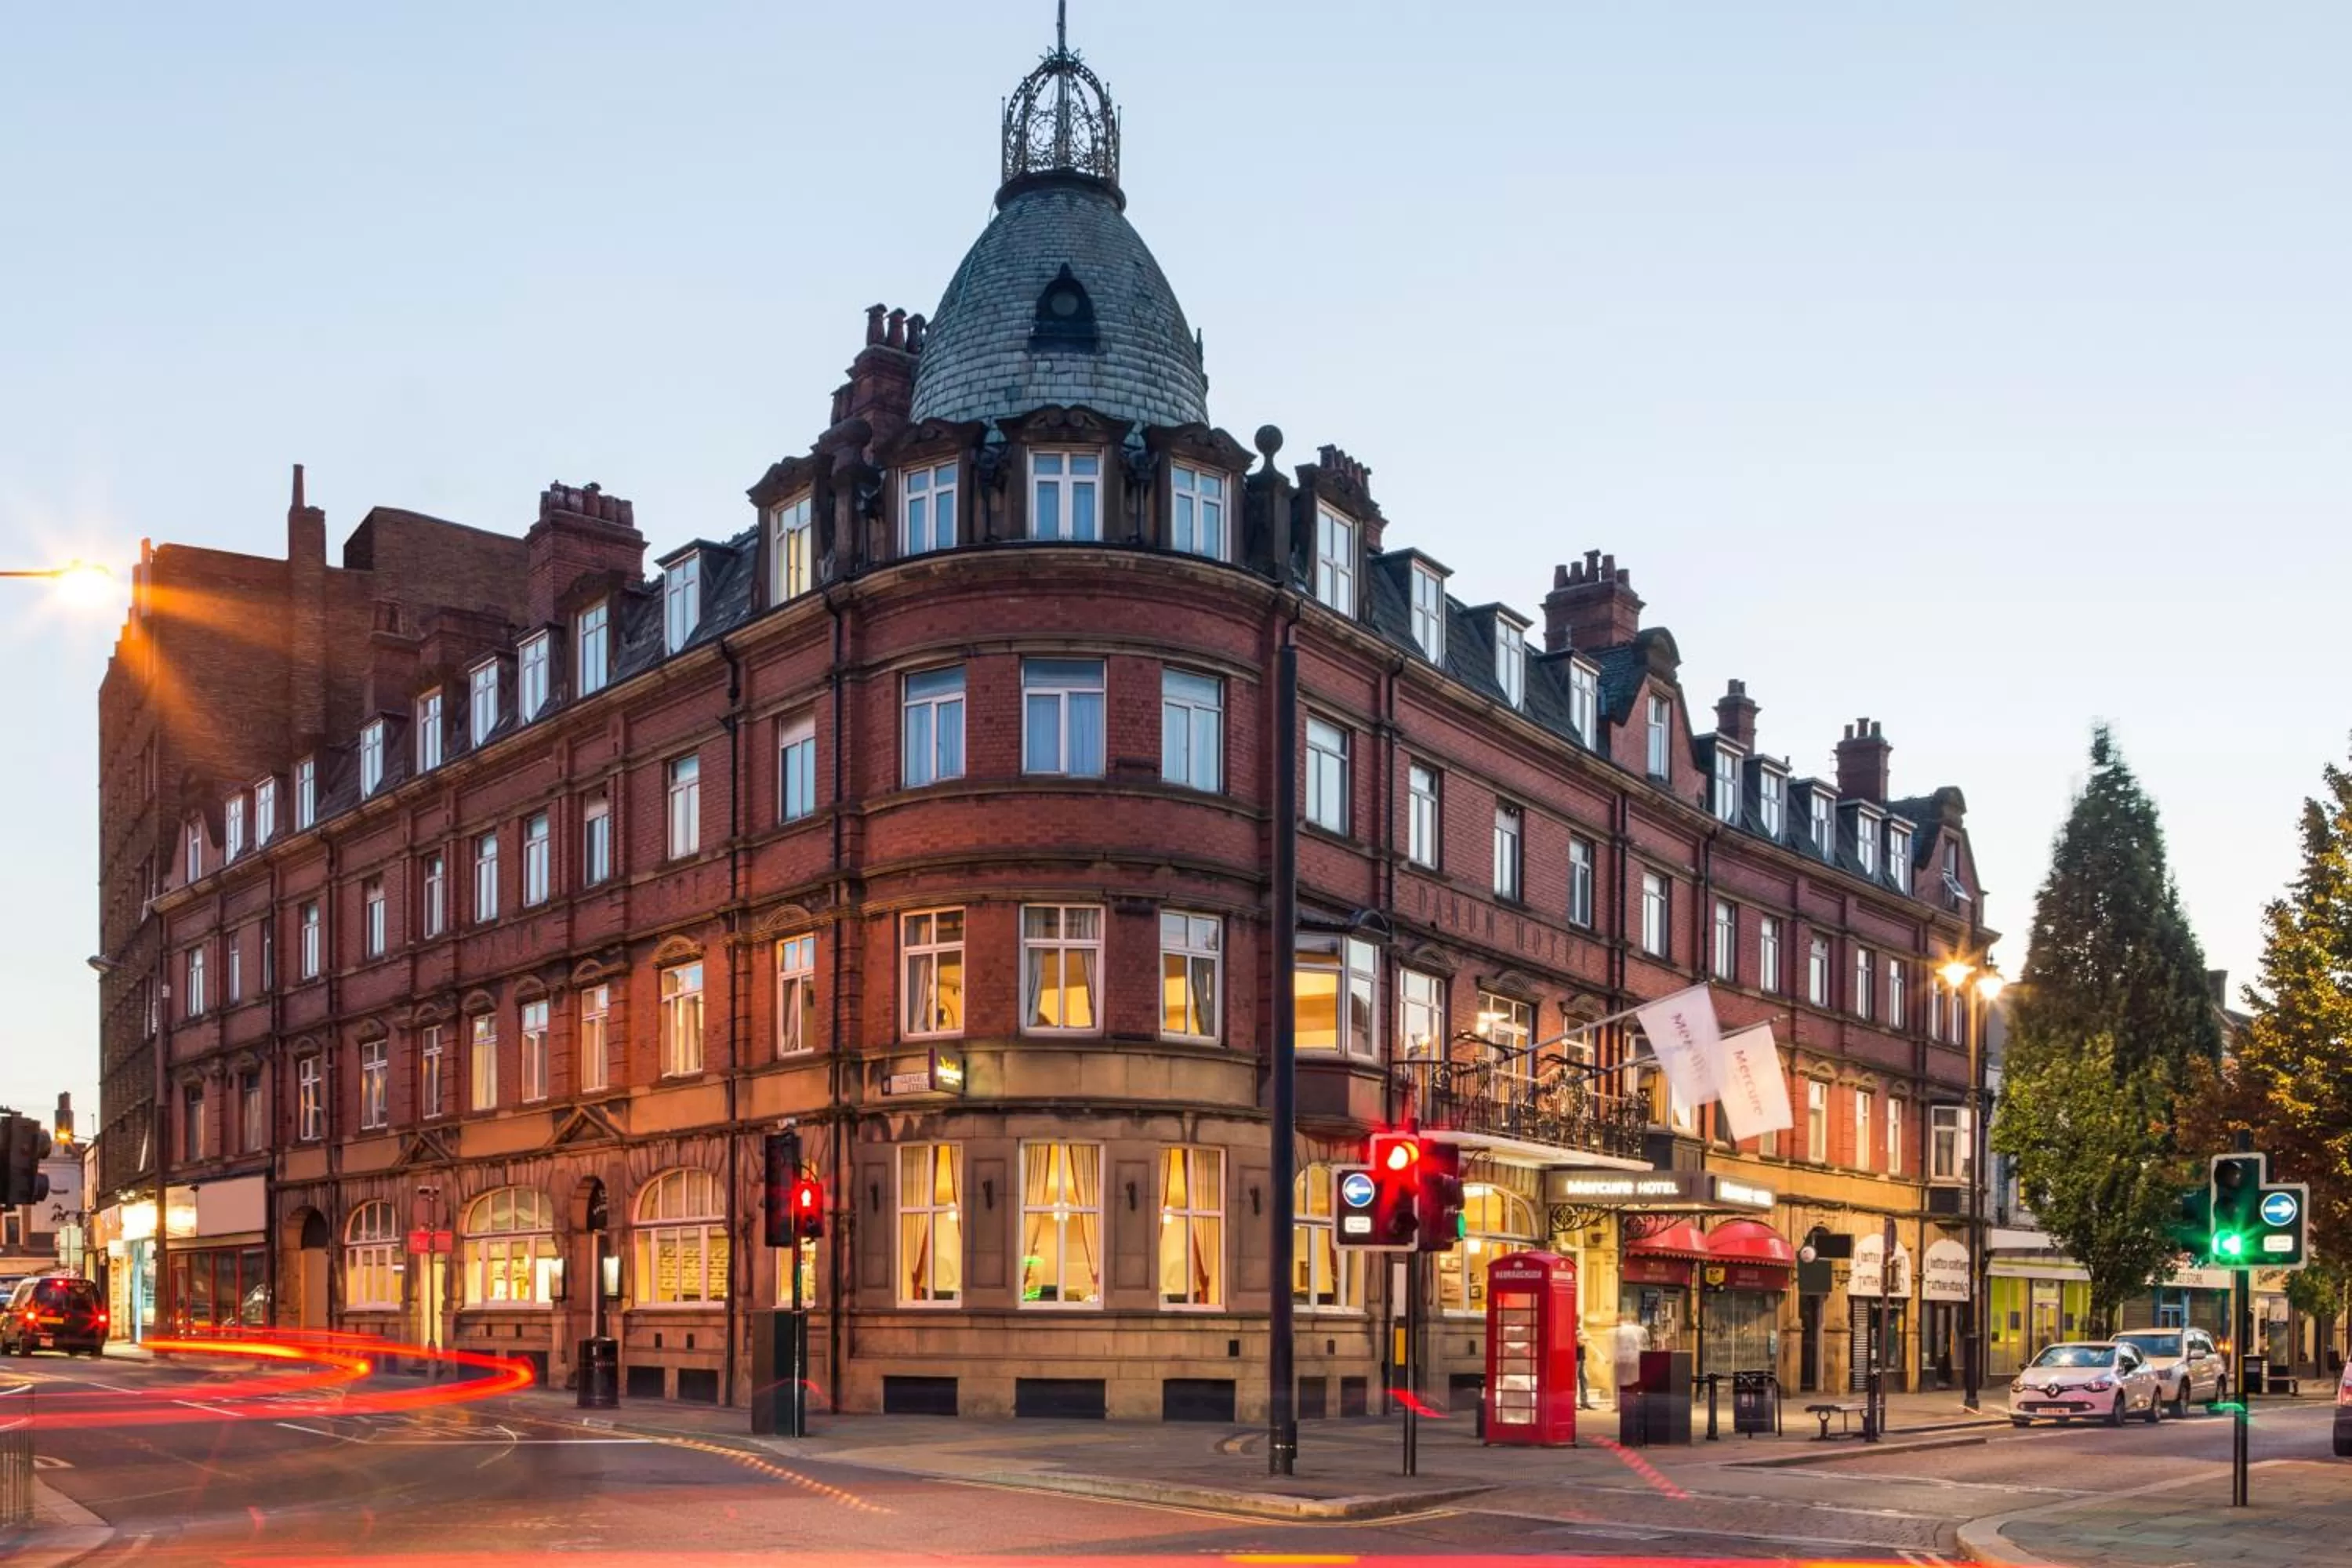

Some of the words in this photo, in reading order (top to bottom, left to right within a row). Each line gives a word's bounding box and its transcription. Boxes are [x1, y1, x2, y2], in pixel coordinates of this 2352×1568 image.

[1419, 885, 1495, 940] DANUM
[1515, 920, 1588, 973] HOTEL
[1733, 1050, 1763, 1116] Mercure
[1638, 1181, 1678, 1194] HOTEL
